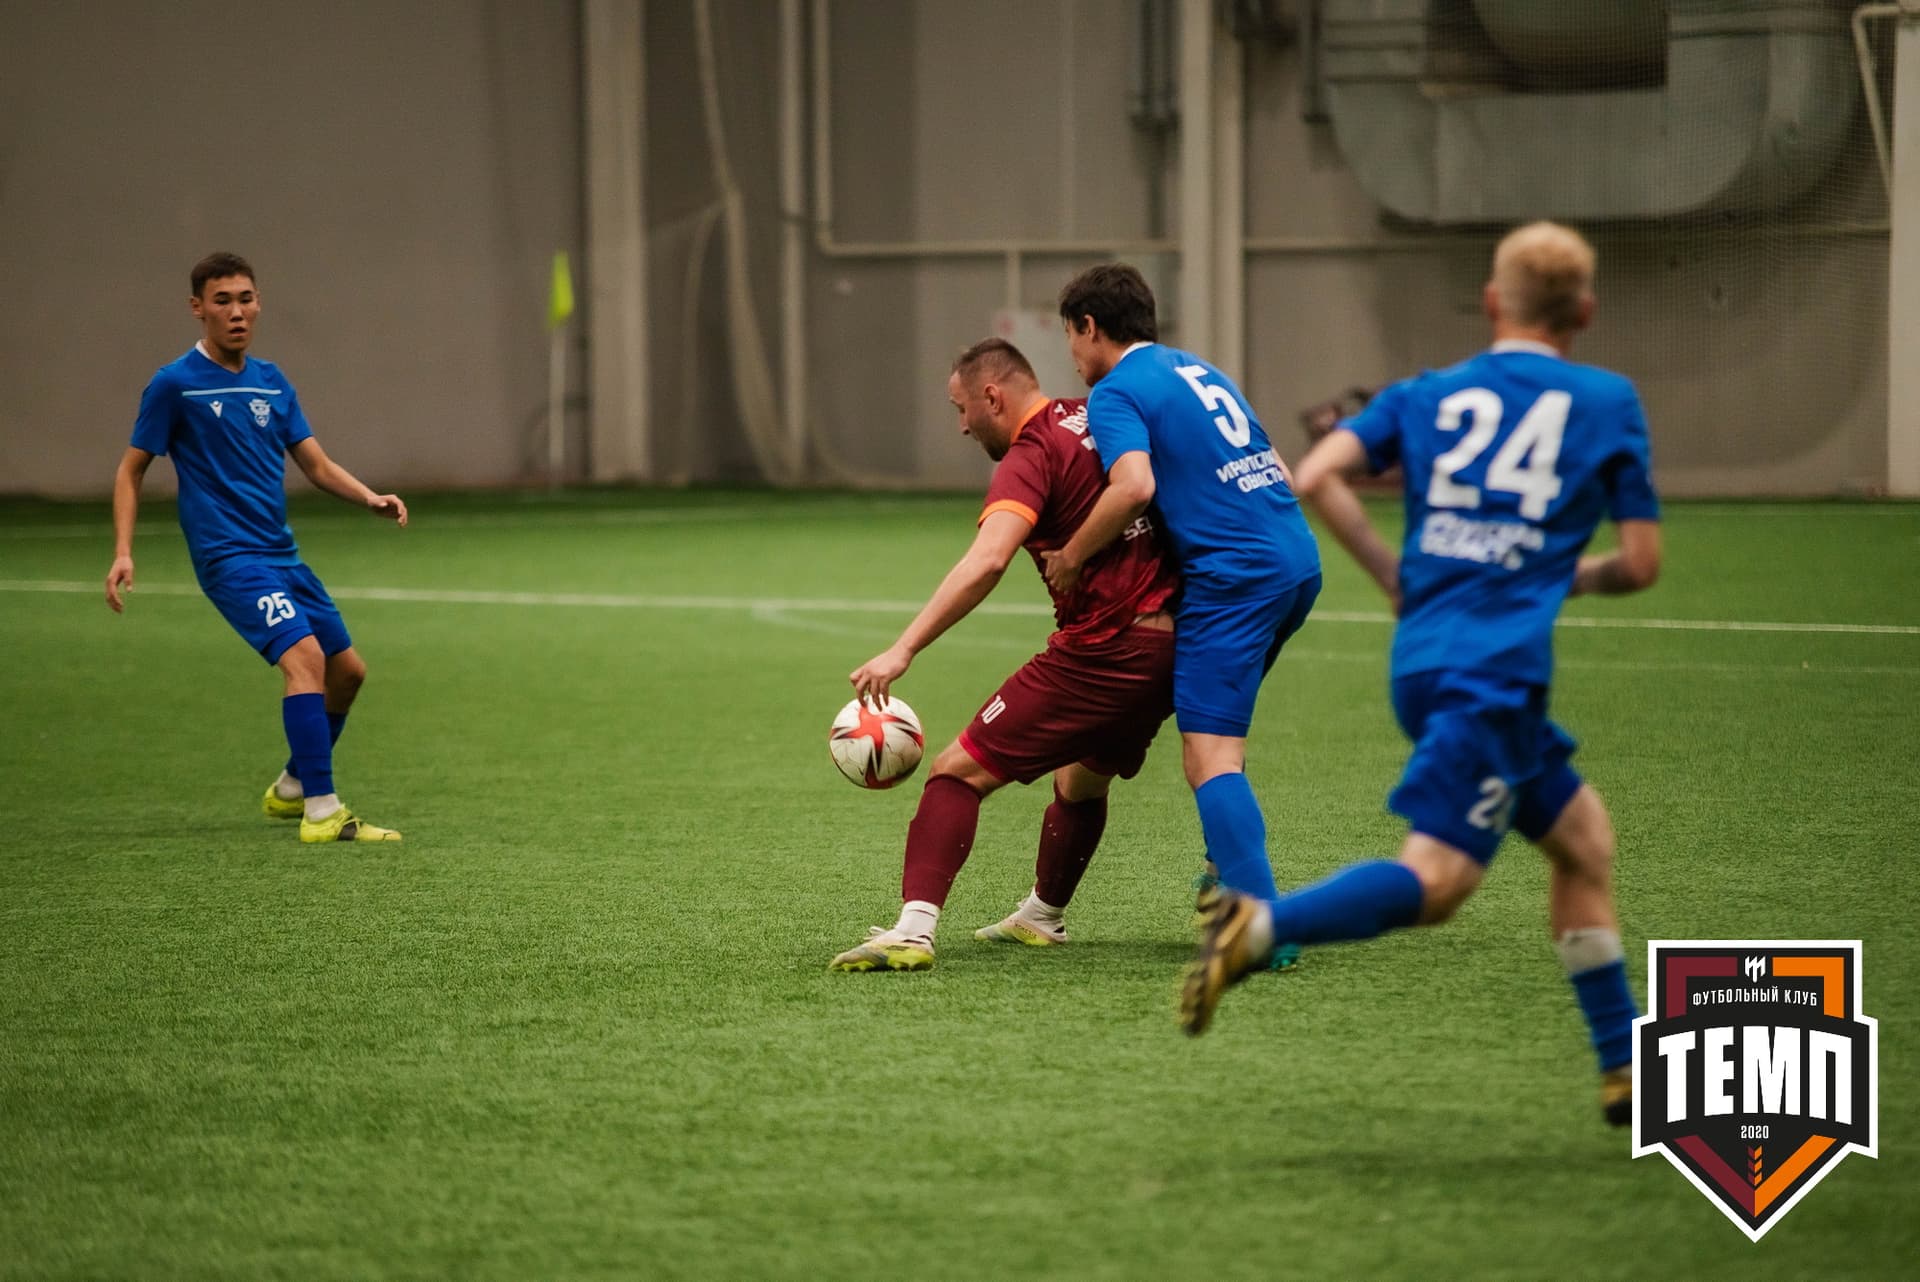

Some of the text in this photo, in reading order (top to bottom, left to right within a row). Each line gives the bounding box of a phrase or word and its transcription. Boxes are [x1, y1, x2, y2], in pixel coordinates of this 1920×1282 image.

[1175, 364, 1251, 448] 5
[1427, 387, 1573, 521] 24
[257, 592, 296, 627] 25
[981, 694, 1007, 725] 10
